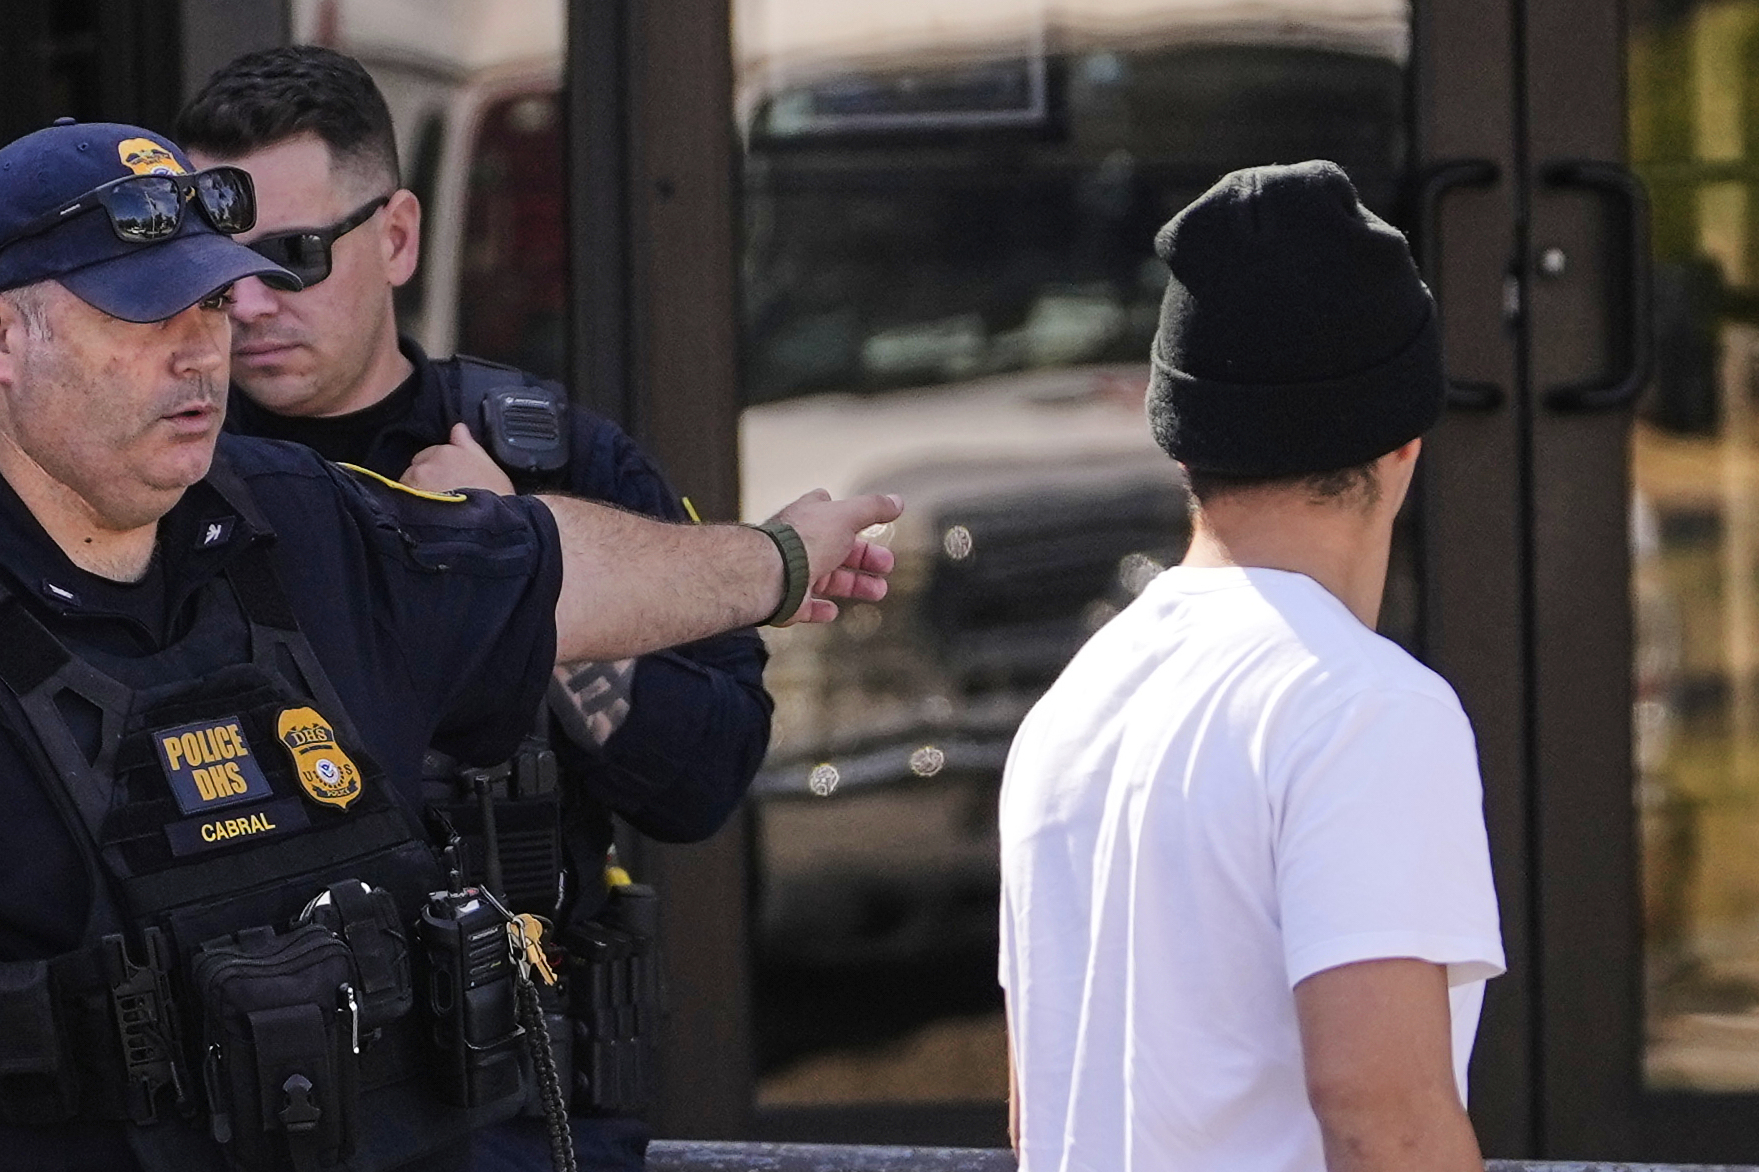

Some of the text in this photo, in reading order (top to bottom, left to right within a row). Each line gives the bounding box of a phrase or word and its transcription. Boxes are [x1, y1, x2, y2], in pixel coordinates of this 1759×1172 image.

[163, 724, 249, 771] POLICE
[291, 728, 328, 746] DHS
[192, 762, 248, 801] DHS
[201, 813, 276, 842] CABRAL
